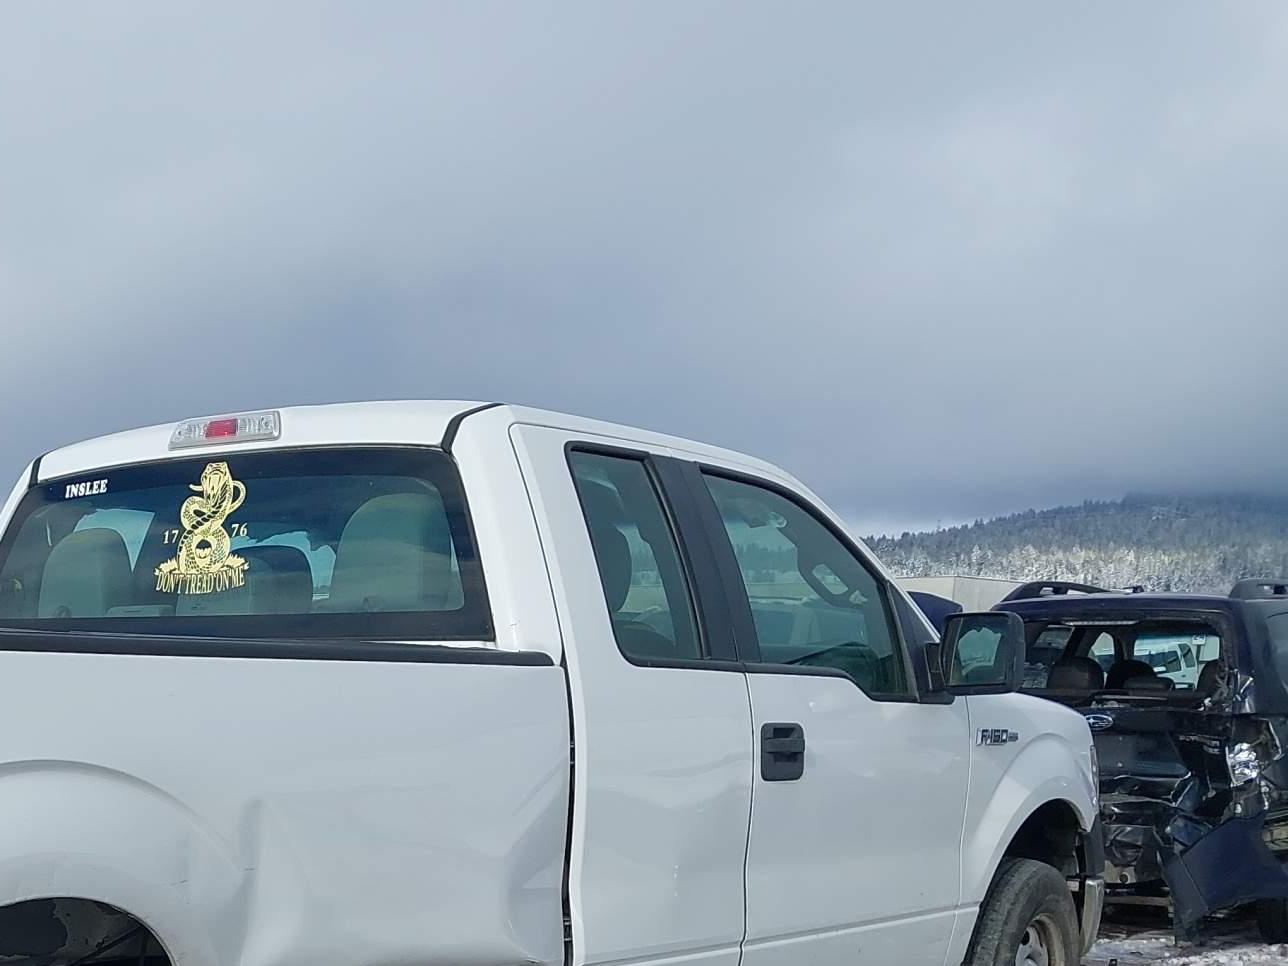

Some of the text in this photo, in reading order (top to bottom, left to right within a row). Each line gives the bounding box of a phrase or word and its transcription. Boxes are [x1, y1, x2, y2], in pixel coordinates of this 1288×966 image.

[65, 479, 108, 499] INSLEE
[163, 522, 248, 544] 17 76
[156, 567, 245, 596] DON'T TREAD ON ME
